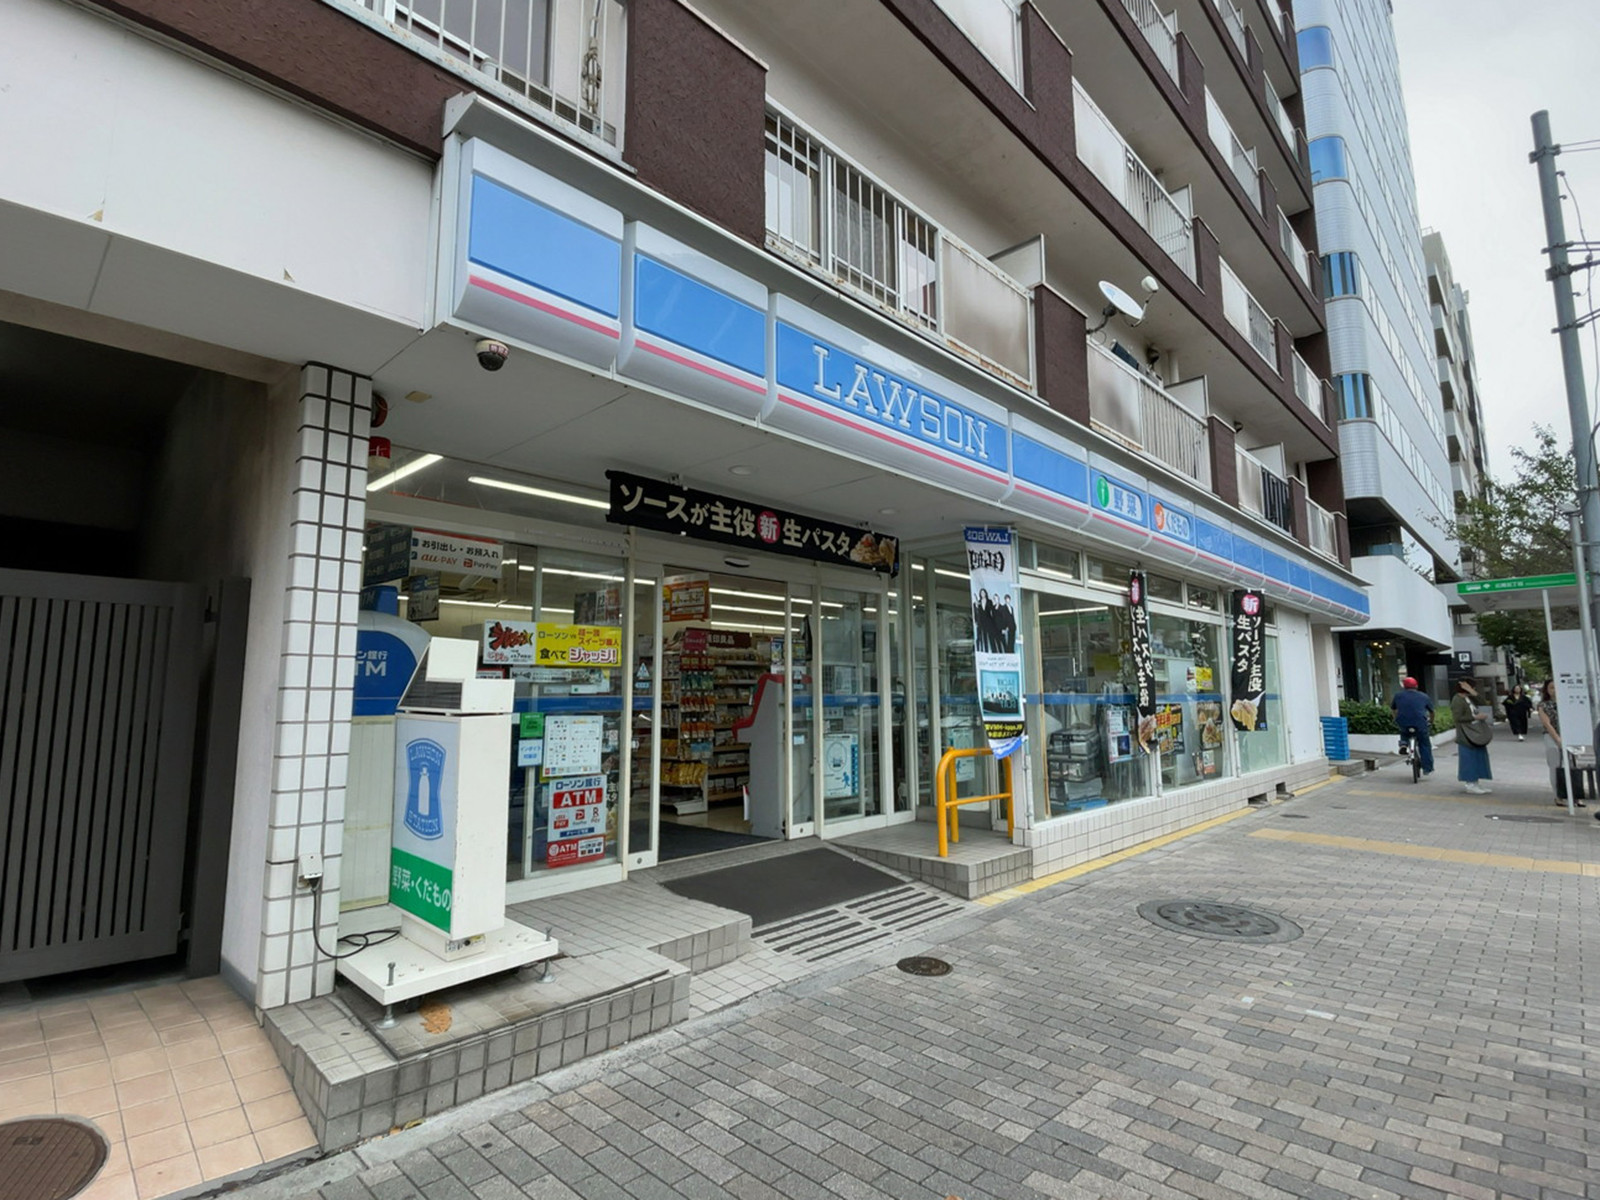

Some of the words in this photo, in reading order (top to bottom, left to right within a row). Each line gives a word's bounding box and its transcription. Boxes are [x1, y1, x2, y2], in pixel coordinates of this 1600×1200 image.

[813, 342, 989, 459] LAWSON
[619, 484, 756, 540] ソースが主役
[759, 514, 778, 541] 新
[782, 518, 851, 555] 生パスタ
[1243, 597, 1258, 614] 新
[538, 631, 570, 640] ローソン
[1236, 614, 1252, 673] 生パスタ
[540, 648, 567, 660] 食べて
[555, 777, 602, 791] ローソン銀行
[560, 789, 597, 807] ATM
[560, 843, 578, 853] ATM
[392, 864, 452, 912] 野菜・くだもの
